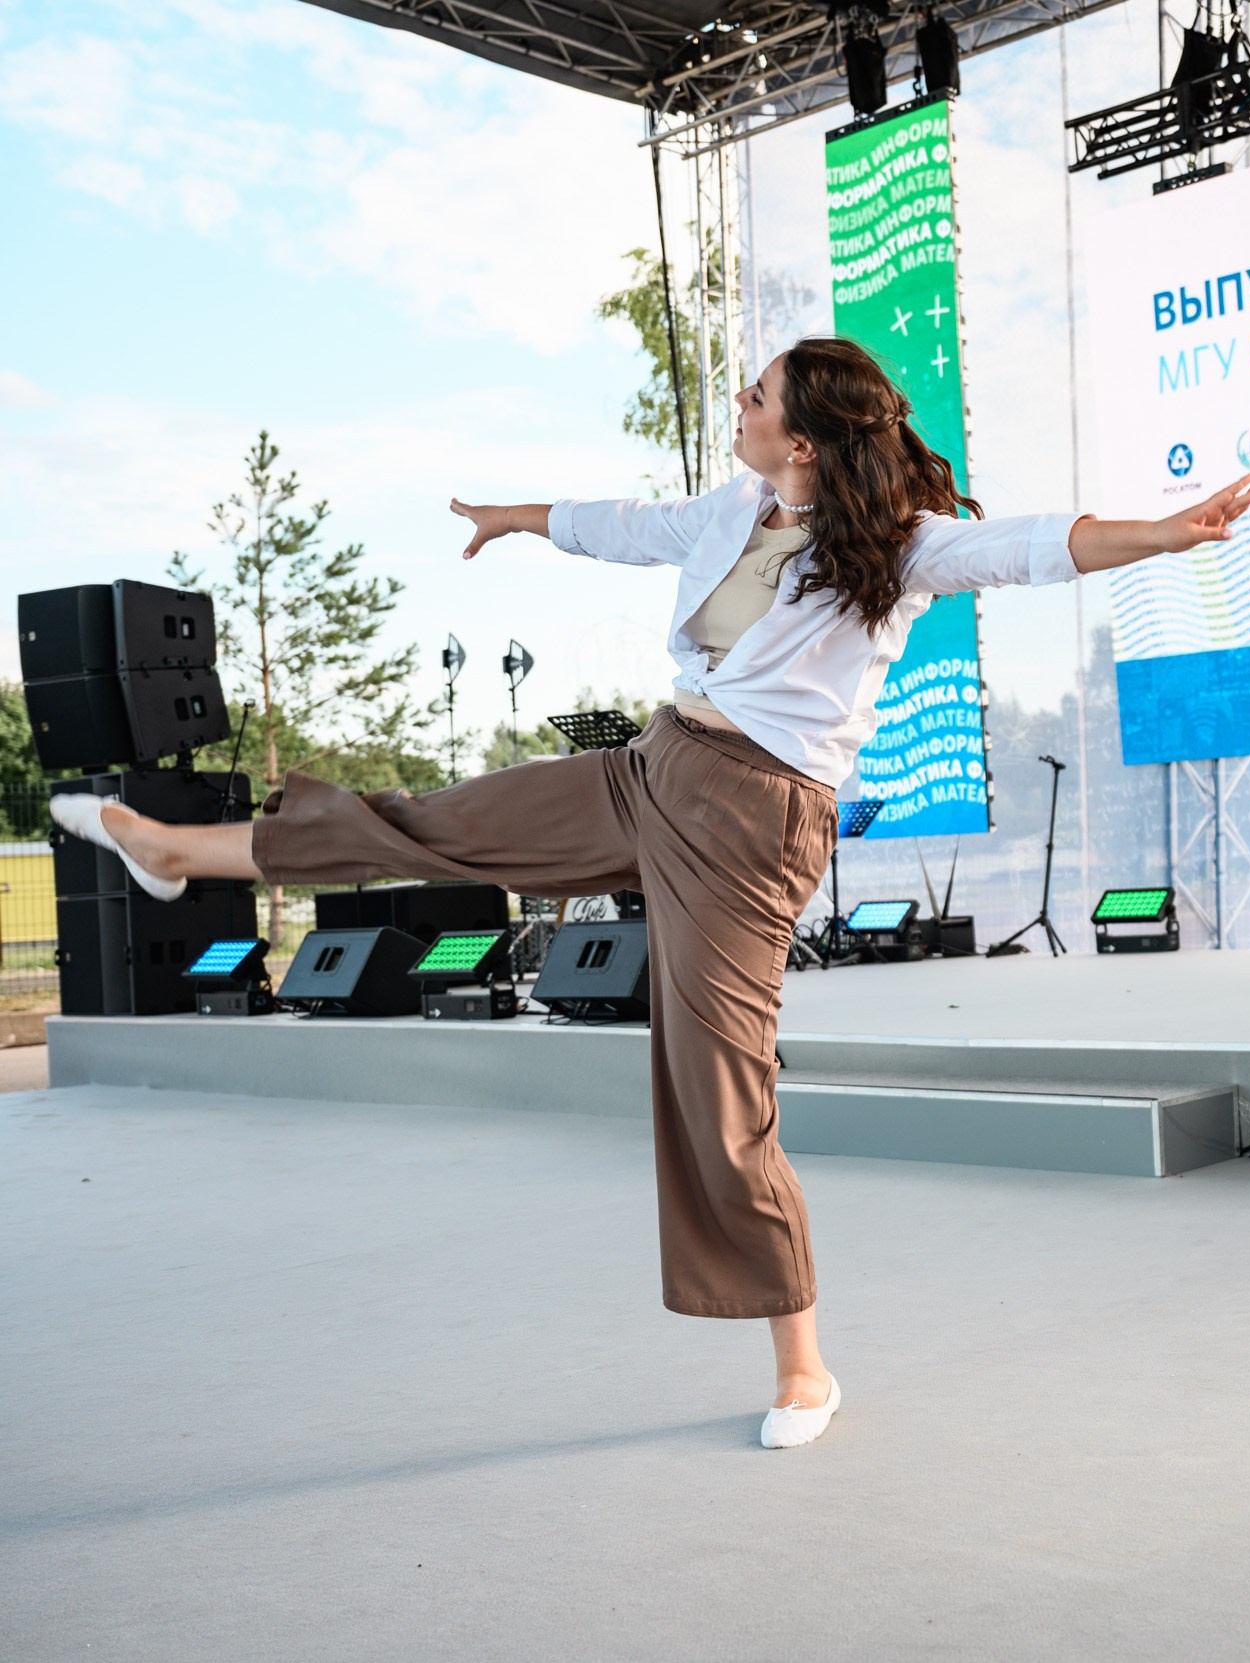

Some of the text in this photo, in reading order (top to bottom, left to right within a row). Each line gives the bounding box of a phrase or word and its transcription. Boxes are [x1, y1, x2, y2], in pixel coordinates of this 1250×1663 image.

[931, 143, 951, 163] Ф
[828, 196, 889, 234] ФИЗИКА
[935, 218, 954, 240] Ф
[835, 265, 898, 305] ФИЗИКА
[1158, 338, 1236, 395] МГУ
[900, 658, 979, 693] ИНФОРМ
[961, 684, 982, 706] Ф
[863, 724, 919, 751] ИЗИКА
[905, 734, 984, 767] ИНФОРМ
[966, 759, 987, 782] Ф
[877, 793, 929, 822] ИЗИКА
